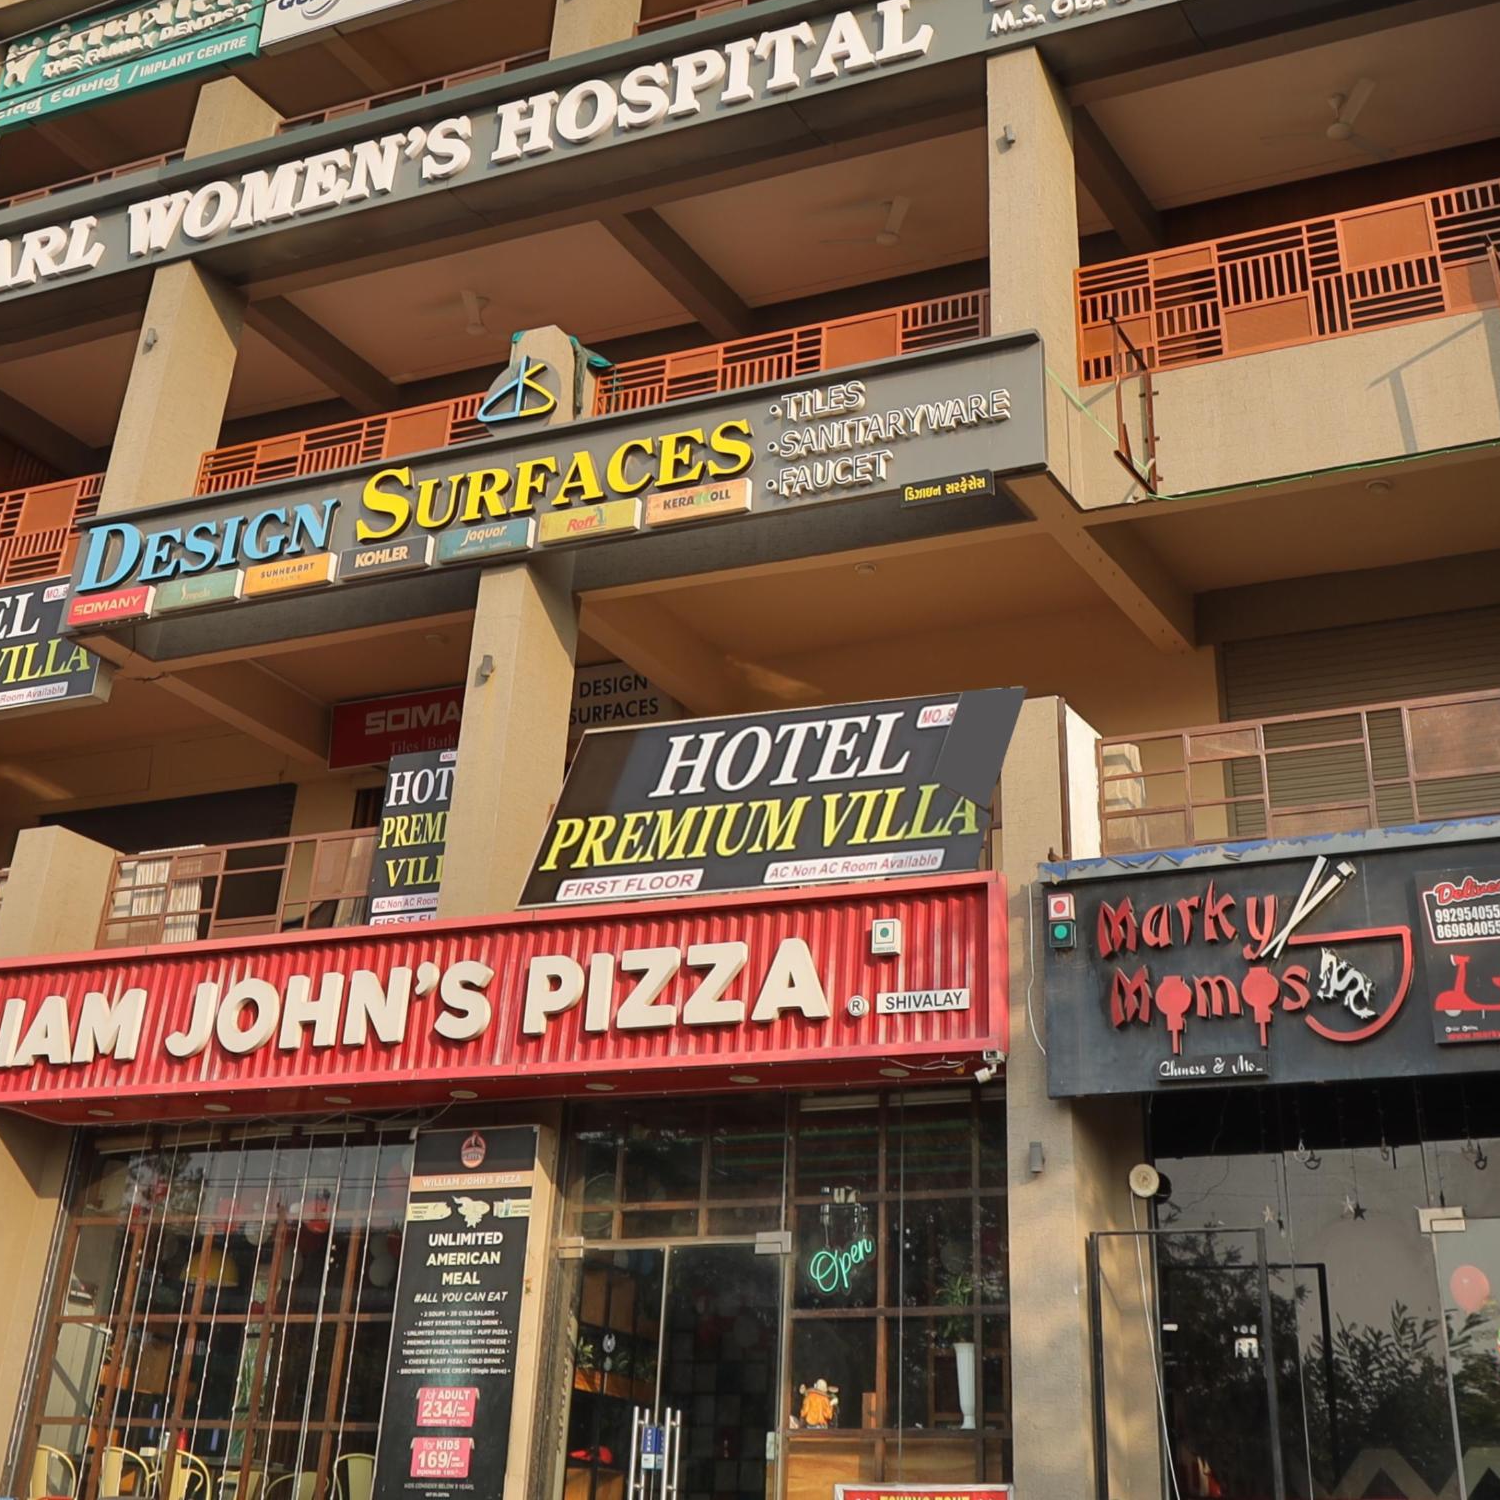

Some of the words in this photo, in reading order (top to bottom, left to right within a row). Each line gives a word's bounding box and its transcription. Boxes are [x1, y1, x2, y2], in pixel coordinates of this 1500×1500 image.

[989, 4, 1046, 36] M.S.
[41, 53, 84, 79] THE
[84, 34, 156, 67] FAMILY
[158, 3, 252, 42] DENTIST
[140, 51, 193, 77] IMPLANT
[197, 35, 248, 60] CENTRE
[127, 113, 474, 257] WOMEN'S
[781, 380, 866, 421] TILES
[779, 389, 1011, 461] SANITARYWARE
[779, 449, 893, 497] FAUCET
[74, 497, 343, 594] DESIGN
[354, 417, 756, 542] SURFACES
[566, 513, 597, 533] Roff
[354, 545, 409, 569] KOHLER
[73, 594, 143, 617] SOMANY
[0, 691, 25, 704] Room
[26, 683, 66, 701] Available
[579, 674, 648, 699] DESIGN
[570, 698, 658, 726] SURFACES
[390, 739, 419, 753] Tiles
[649, 713, 912, 799] HOTEL
[539, 797, 812, 871] PREMIUM
[822, 783, 980, 848] VILLA
[768, 866, 791, 880] AC
[792, 864, 818, 877] Non
[819, 861, 840, 875] AC
[841, 859, 878, 874] Room
[880, 853, 939, 871] Available
[564, 880, 619, 898] FIRST
[624, 873, 695, 892] FLOOR
[1097, 878, 1279, 960] Marky
[165, 961, 494, 1058] JOHN'S
[524, 937, 832, 1035] PIZZA
[885, 991, 964, 1011] SHIVALAY
[1213, 1057, 1226, 1074] &
[422, 1175, 460, 1188] WILLIAM
[495, 1174, 522, 1184] PIZZA
[428, 1231, 504, 1247] UNLIMITED
[426, 1251, 501, 1267] AMERICAN
[810, 1238, 872, 1292] Open
[441, 1271, 481, 1286] MEAL
[413, 1292, 439, 1304] #ALL
[441, 1292, 463, 1303] YOU
[464, 1291, 485, 1302] CAN
[487, 1291, 509, 1302] EAT
[492, 1328, 508, 1336] PIZZA
[437, 1390, 470, 1400] ADULT
[436, 1440, 460, 1451] KIDS
